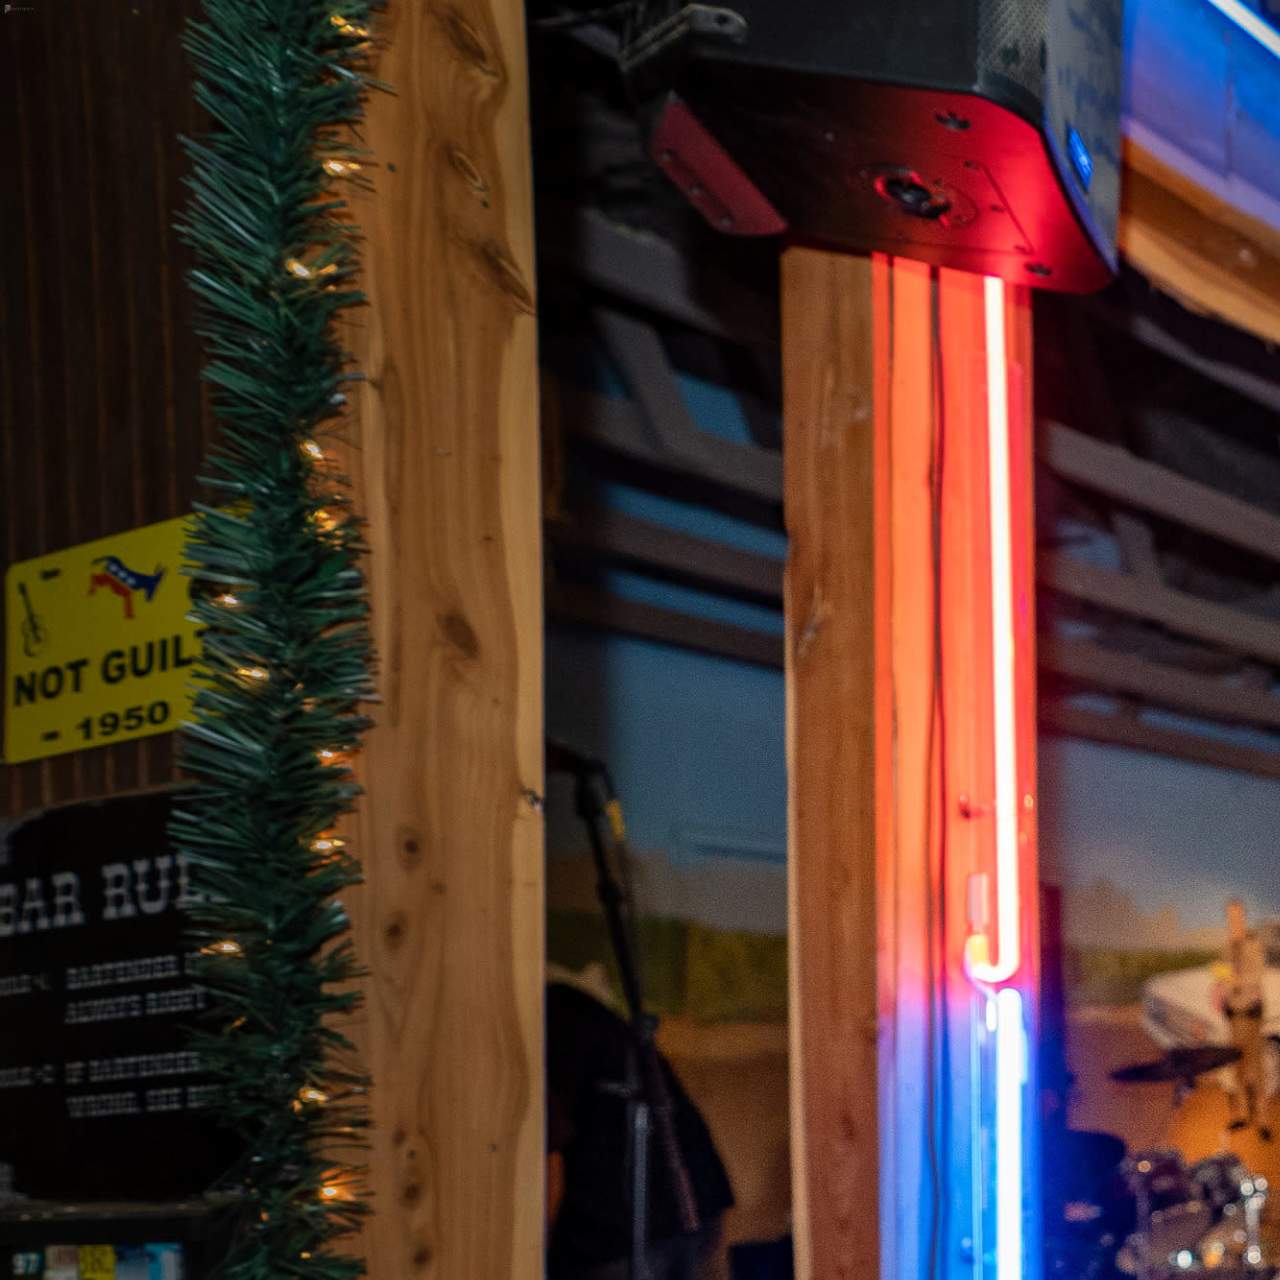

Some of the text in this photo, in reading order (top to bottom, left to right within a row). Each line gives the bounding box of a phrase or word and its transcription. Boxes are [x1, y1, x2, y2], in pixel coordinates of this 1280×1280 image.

[14, 630, 203, 707] NOT GUIL
[76, 701, 170, 741] 1950
